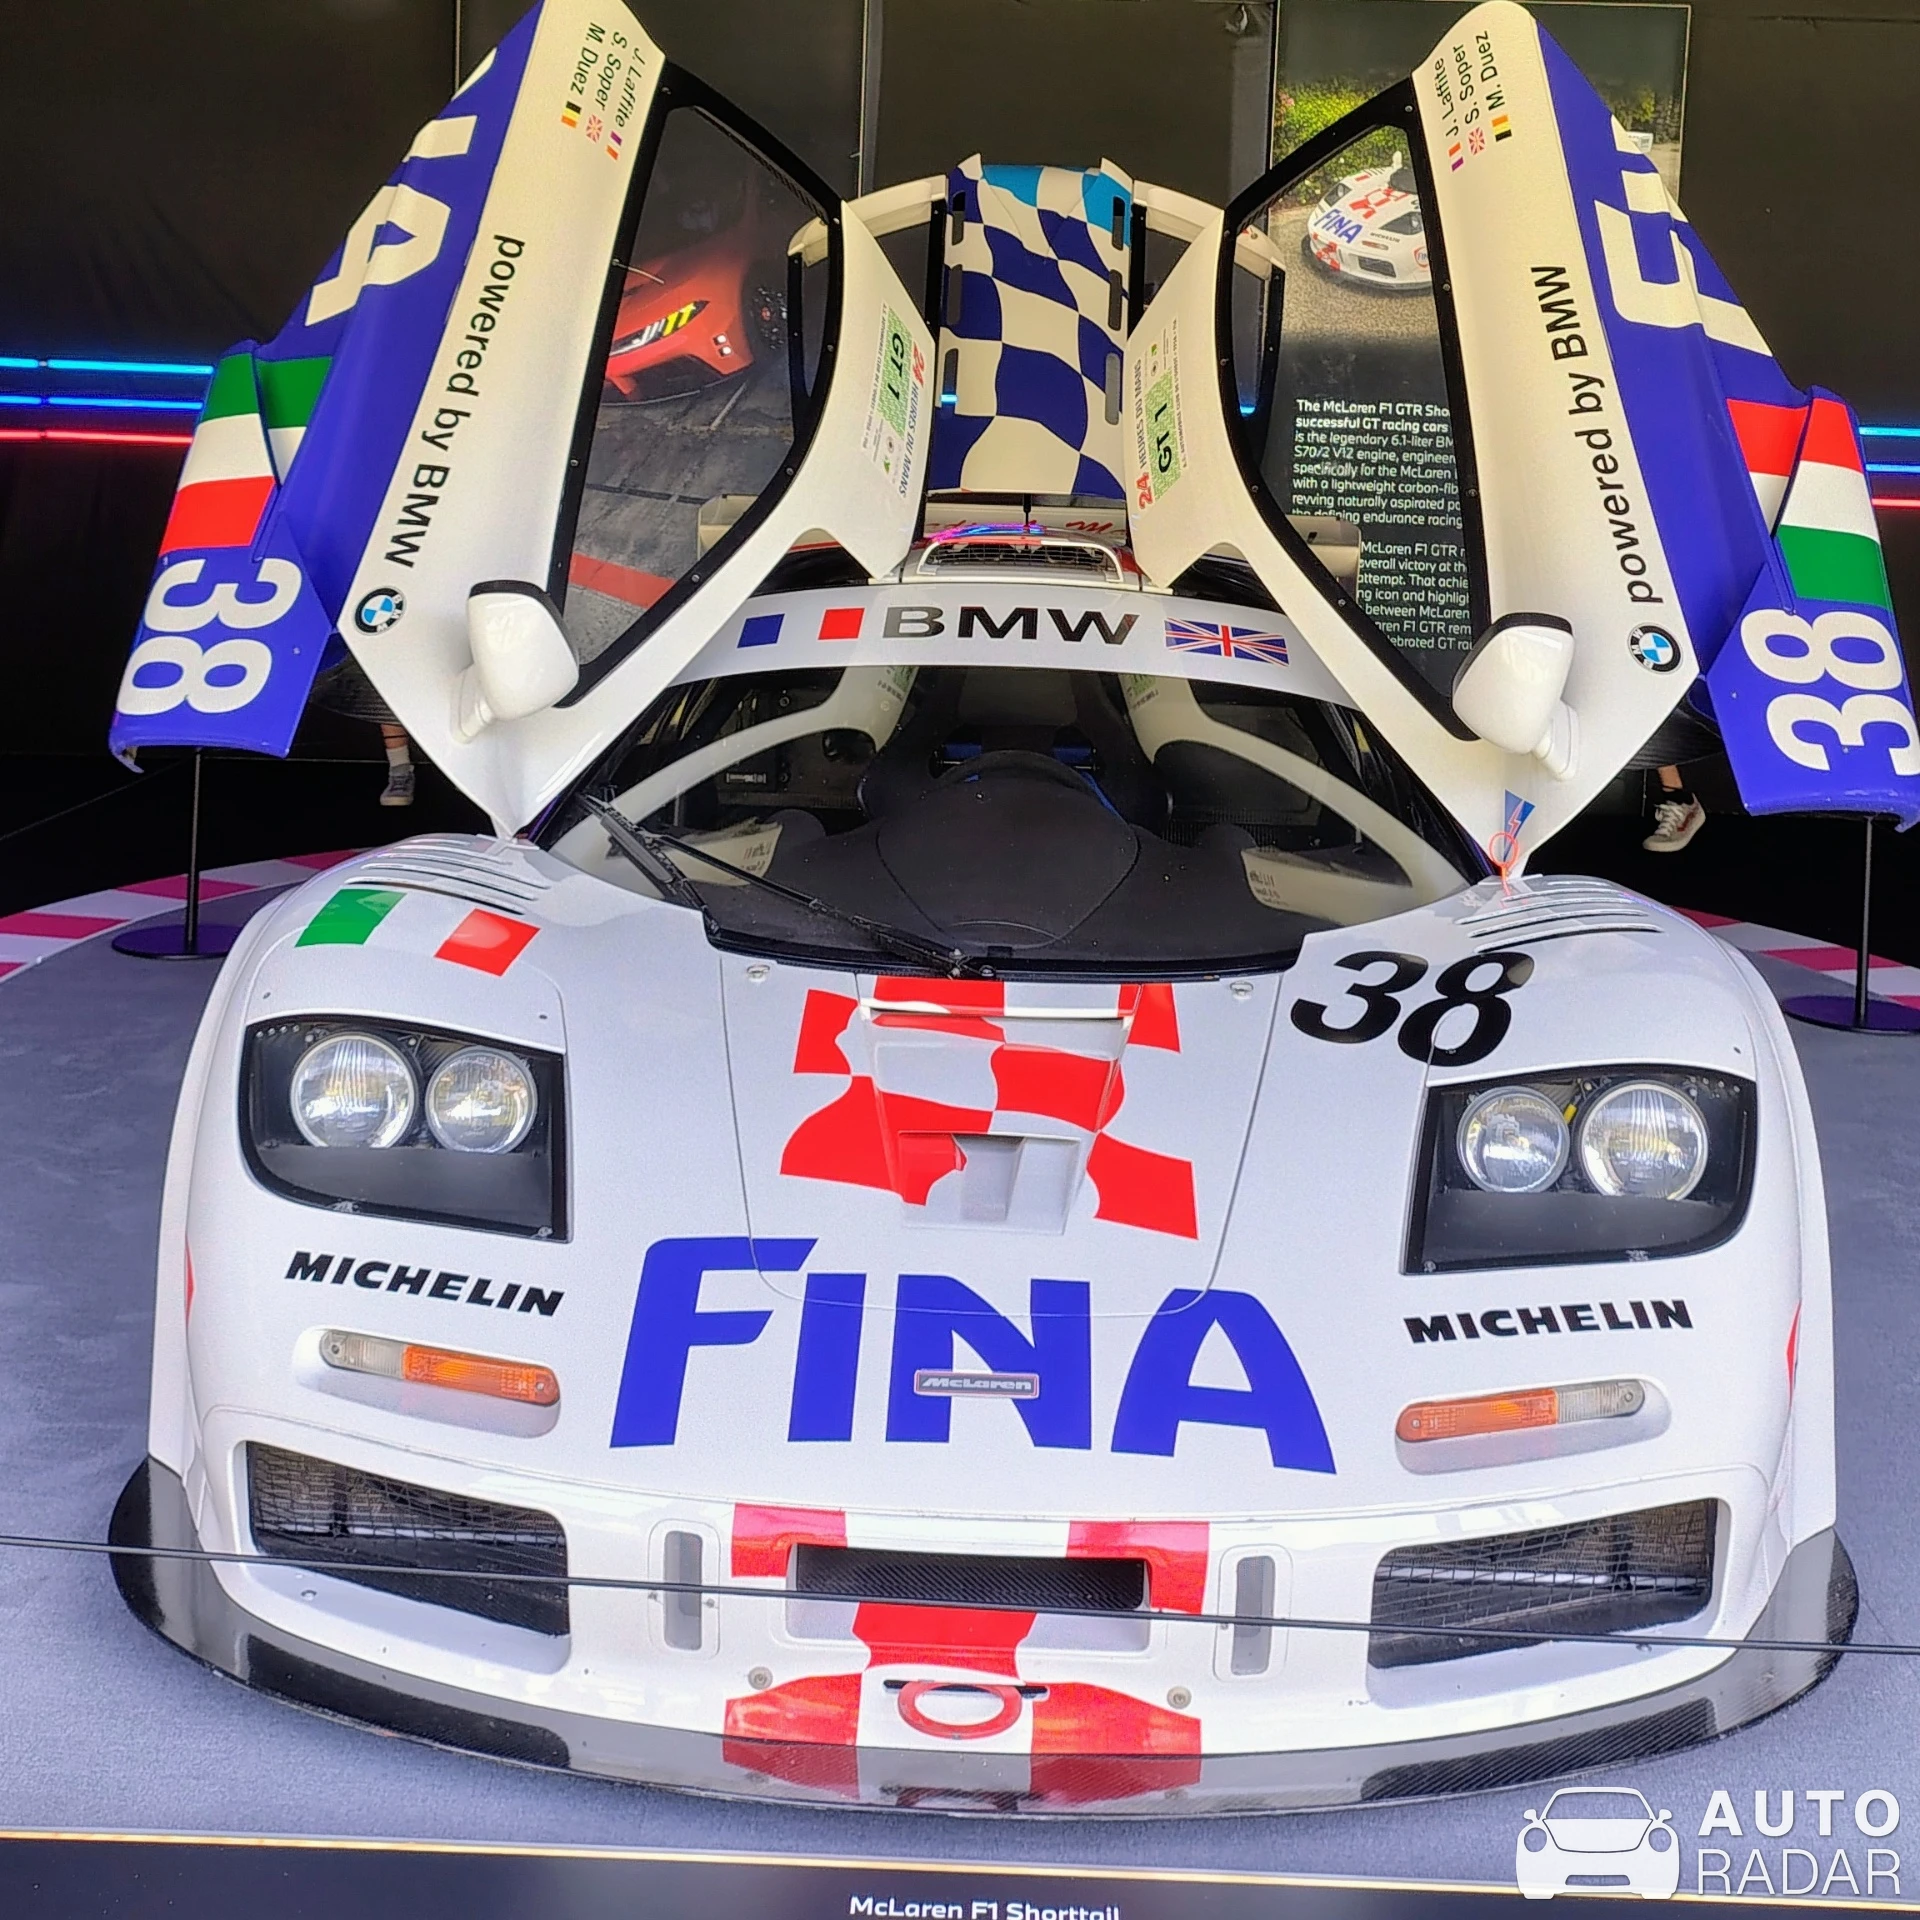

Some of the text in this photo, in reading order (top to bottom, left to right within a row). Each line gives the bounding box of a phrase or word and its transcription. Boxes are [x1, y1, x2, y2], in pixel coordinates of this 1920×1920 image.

[571, 22, 605, 95] M. Duez
[595, 32, 628, 111] S. Soper
[1476, 31, 1505, 110] M. Duez
[616, 66, 642, 127] Laffite
[1435, 58, 1454, 120] Laffite
[1453, 44, 1479, 124] S. Soper
[1314, 209, 1362, 244] FINA
[888, 333, 904, 401] GT 1
[384, 235, 526, 568] powered by BMW
[1297, 399, 1450, 417] The McLaren F1 GTR Sho
[906, 431, 914, 455] DU
[1155, 403, 1172, 473] GT 1
[1295, 431, 1304, 442] is
[1307, 431, 1327, 443] the
[1330, 432, 1388, 447] legendary
[1391, 434, 1433, 447] 6.1-liter
[1296, 417, 1448, 434] successful GT racing cars
[1531, 266, 1664, 603] powered by BMW
[1293, 462, 1358, 478] specifically
[1361, 464, 1376, 476] for
[1378, 465, 1397, 477] the
[1400, 466, 1450, 479] McLaren
[1294, 446, 1456, 464] S70/2 V12 engine, engineer
[899, 454, 911, 498] MANS
[1136, 472, 1153, 510] 24
[1293, 477, 1317, 489] with
[1321, 480, 1329, 489] a
[1331, 479, 1395, 494] lightweight
[1292, 493, 1334, 508] revving
[1338, 495, 1388, 509] naturally
[1390, 498, 1444, 512] aspirated
[1363, 511, 1424, 524] endurance
[1428, 514, 1463, 530] racing
[1361, 542, 1412, 554] McLaren
[1415, 543, 1427, 556] F1
[1431, 544, 1457, 557] GTR
[1398, 559, 1436, 573] victory
[1439, 563, 1451, 572] at
[1454, 562, 1467, 573] th
[1358, 574, 1406, 587] attempt.
[1409, 574, 1436, 586] That
[1375, 588, 1399, 600] icon
[1402, 590, 1424, 601] and
[883, 606, 1140, 645] BMW
[1366, 604, 1470, 619] between McLaren
[1404, 621, 1415, 632] F1
[1420, 621, 1445, 634] GTR
[1448, 625, 1471, 635] rem
[117, 558, 302, 715] 38
[1388, 635, 1434, 648] ebrated
[1438, 637, 1456, 649] GT
[1741, 608, 1920, 776] 38
[1290, 951, 1535, 1067] 38
[284, 1251, 565, 1317] MICHELIN
[1403, 1300, 1694, 1344] MICHELIN
[610, 1237, 1336, 1474] FINA
[922, 1378, 1032, 1390] McLaren
[850, 1896, 1120, 1920] McLaren F1 Shorttail
